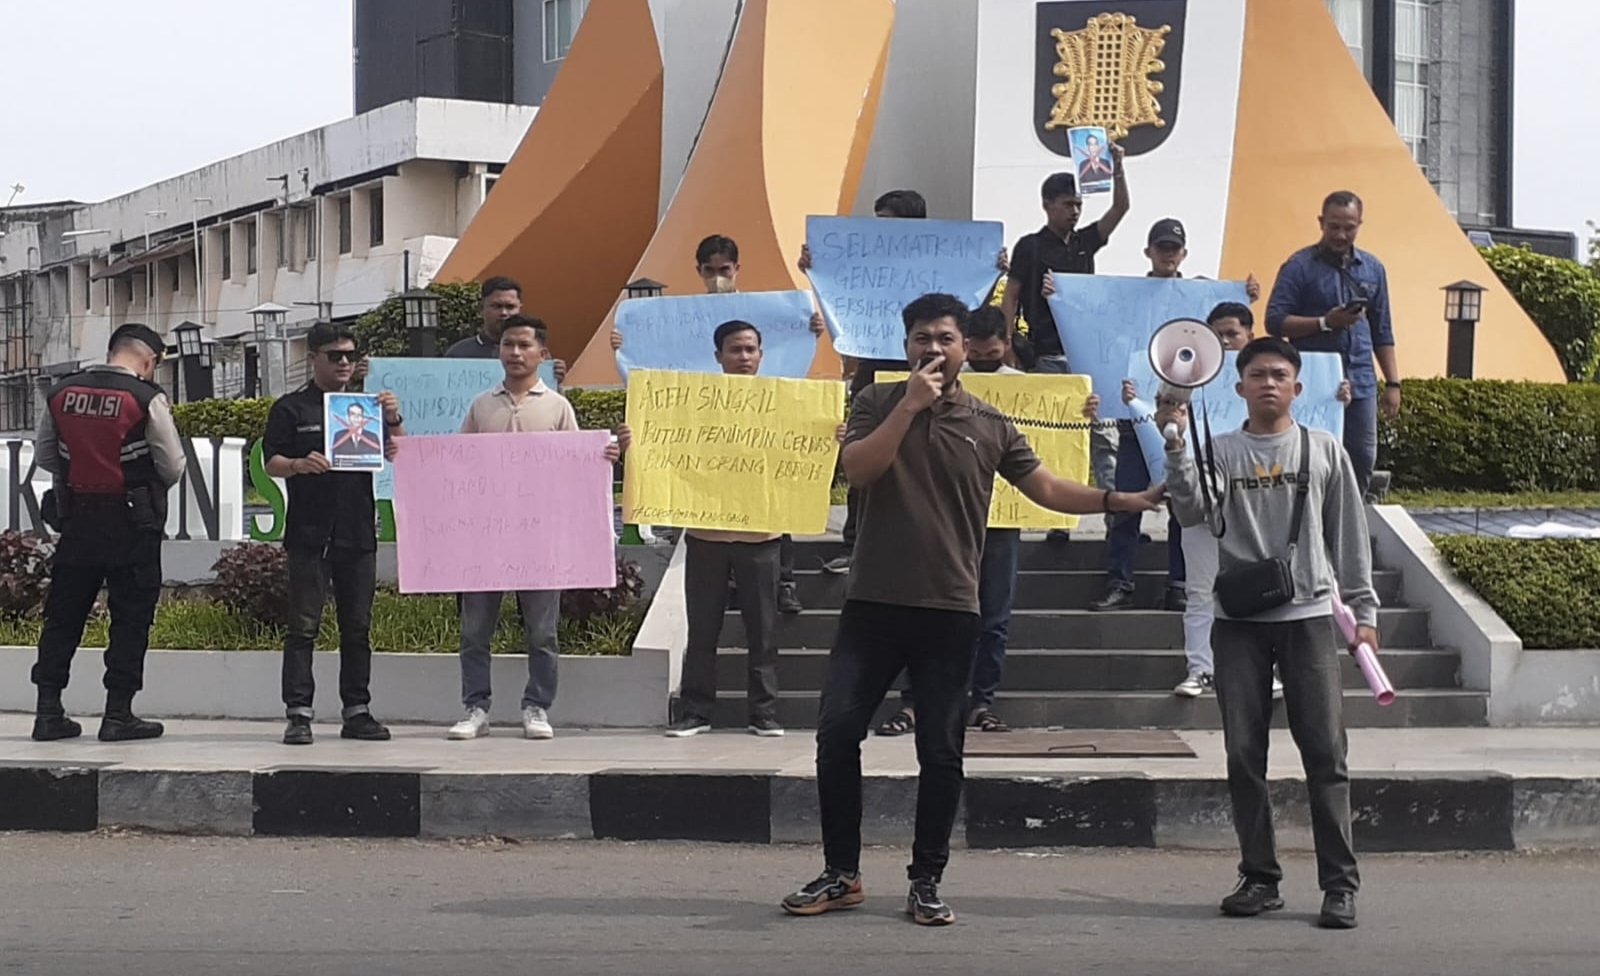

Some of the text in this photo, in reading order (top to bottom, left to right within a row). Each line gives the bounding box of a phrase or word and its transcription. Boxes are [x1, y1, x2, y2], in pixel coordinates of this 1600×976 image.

[822, 231, 985, 261] SELAMATKAN
[63, 391, 122, 418] POLISI
[640, 380, 778, 415] ACEH SINGKIL
[641, 420, 693, 446] BUTUH
[643, 449, 702, 473] BUKAN
